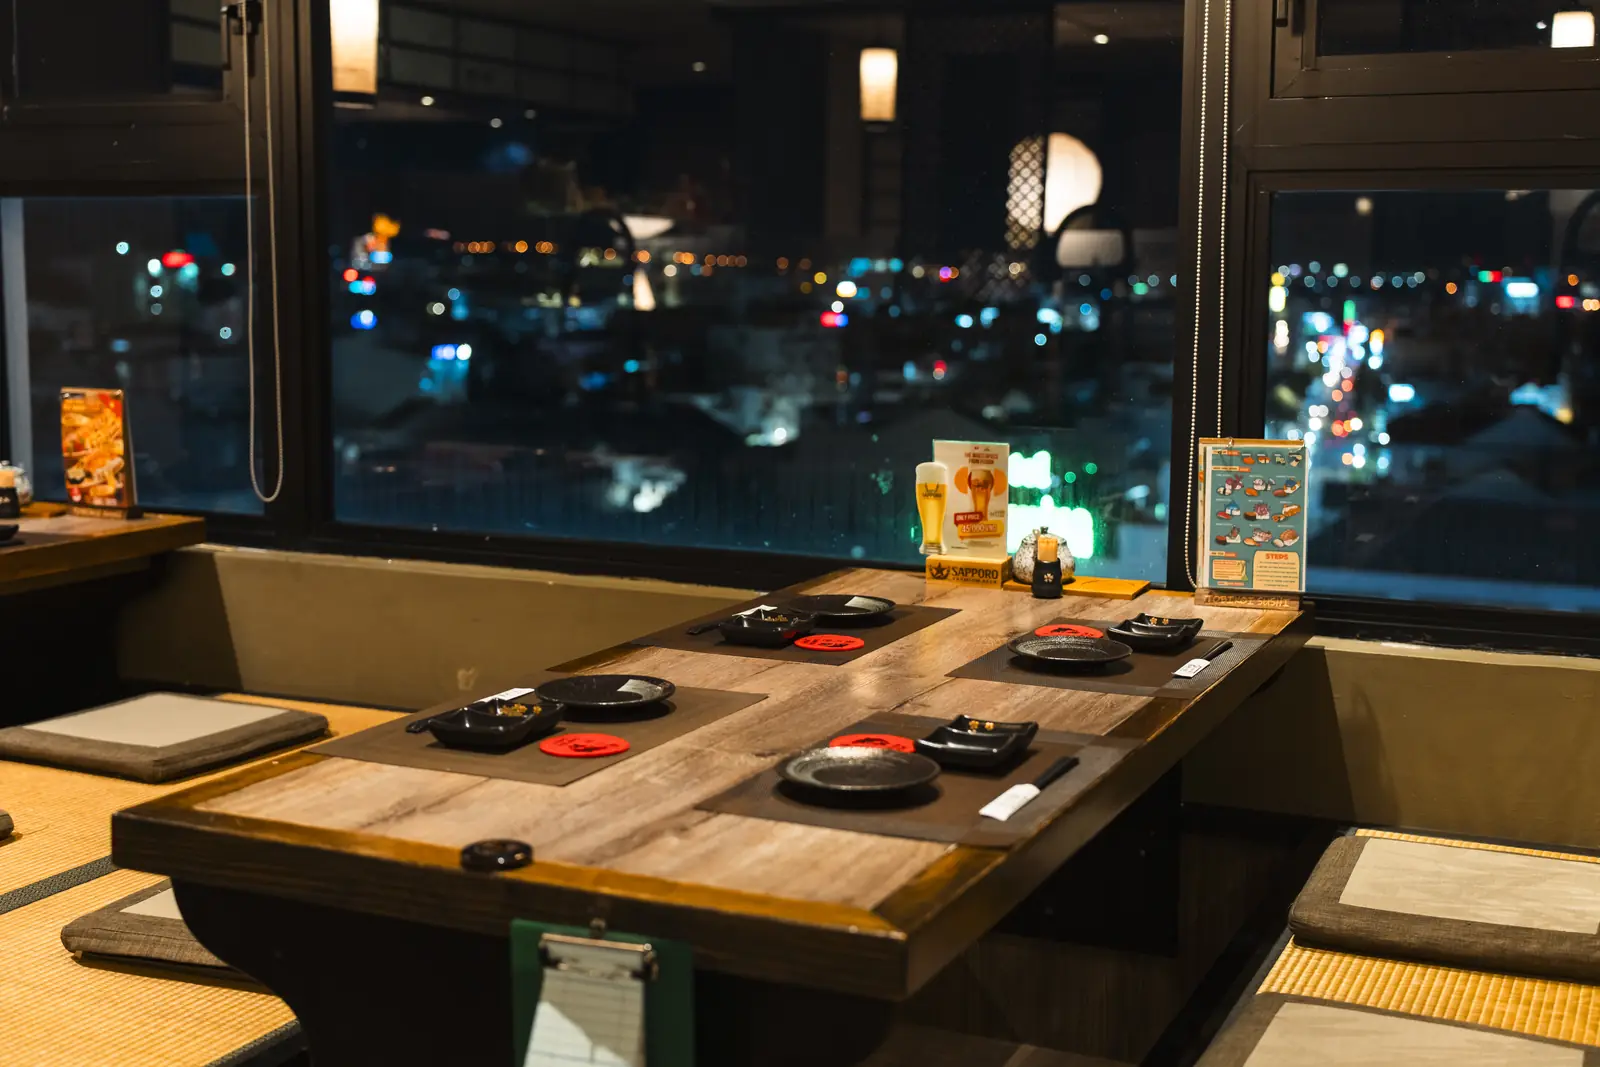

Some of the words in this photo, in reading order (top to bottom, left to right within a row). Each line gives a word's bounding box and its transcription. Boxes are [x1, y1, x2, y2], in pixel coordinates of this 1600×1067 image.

[1265, 552, 1289, 561] STEPS
[951, 566, 999, 580] SAPPORO
[1257, 596, 1290, 608] SUSHI
